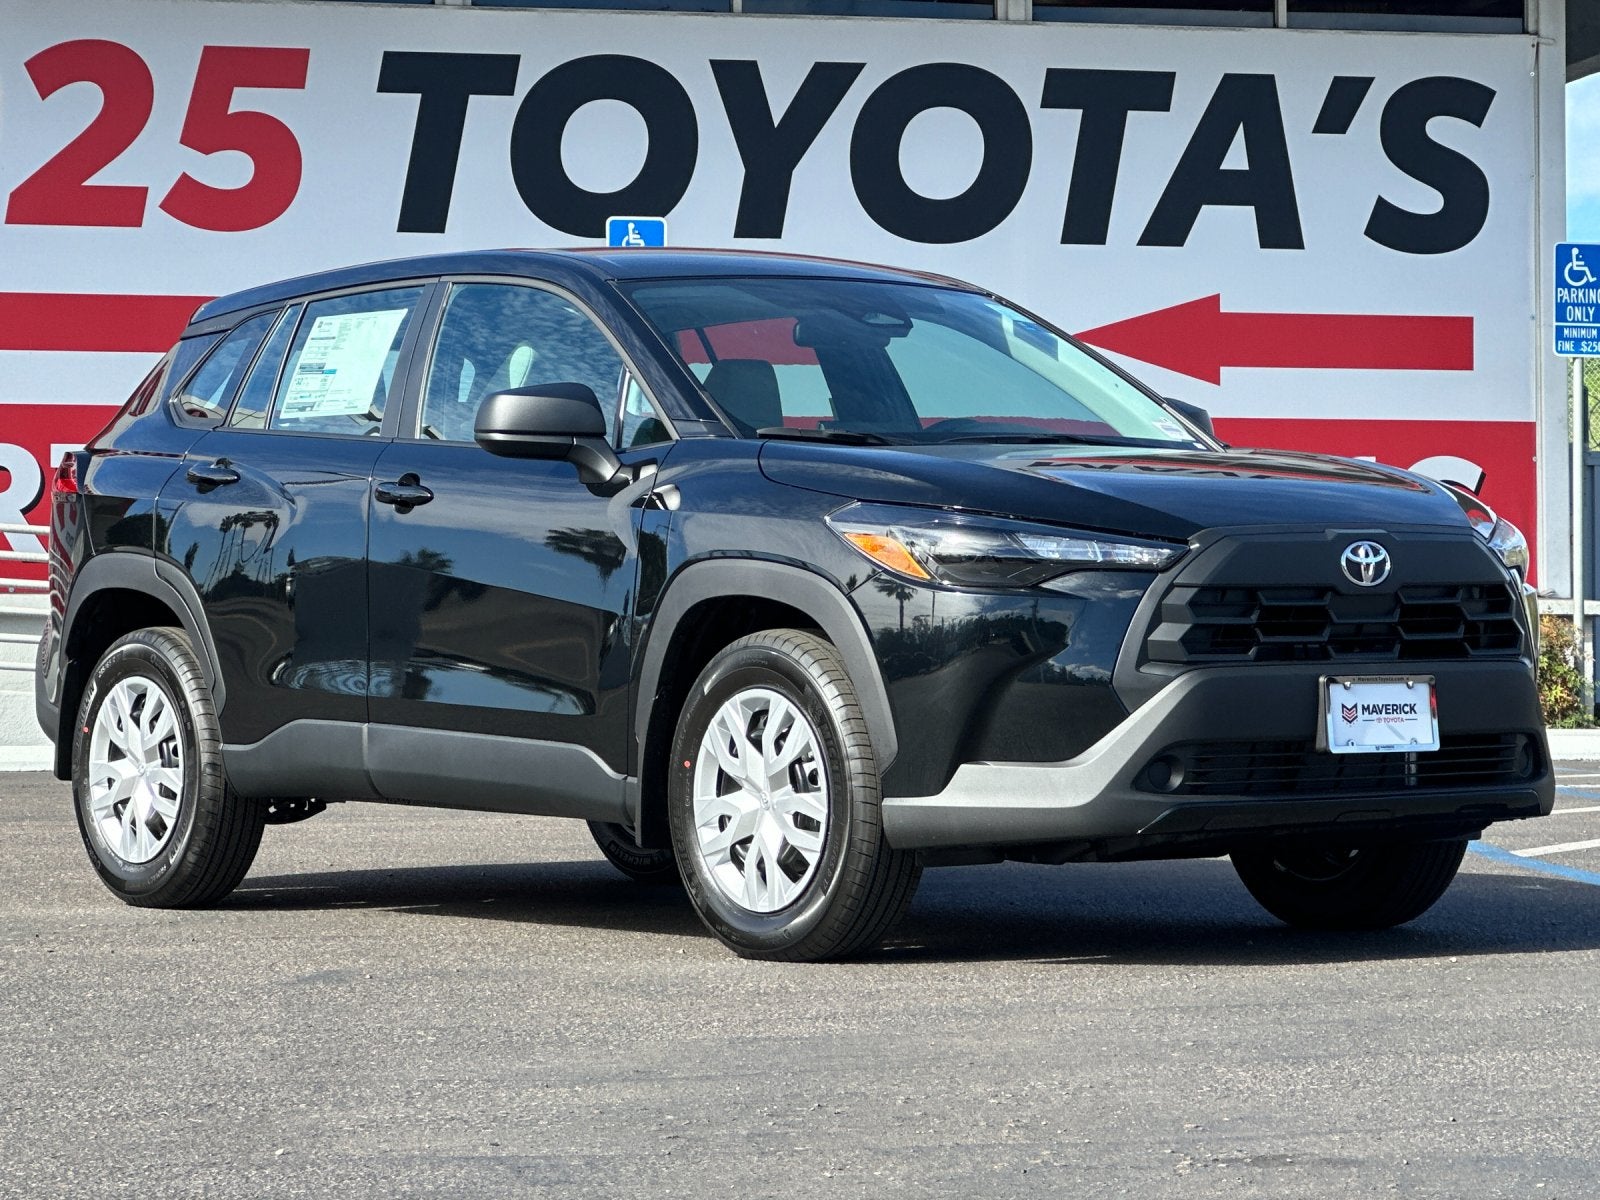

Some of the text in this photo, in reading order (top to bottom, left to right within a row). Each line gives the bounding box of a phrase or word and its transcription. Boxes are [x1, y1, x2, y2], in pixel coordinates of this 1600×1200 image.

[6, 40, 1497, 254] 25 TOYOTA'S
[1566, 305, 1596, 322] ONLY
[1563, 327, 1598, 339] MINIMUM
[1557, 340, 1575, 352] FINE
[1361, 703, 1418, 715] MAVERICK
[1383, 716, 1405, 724] TOYOTA
